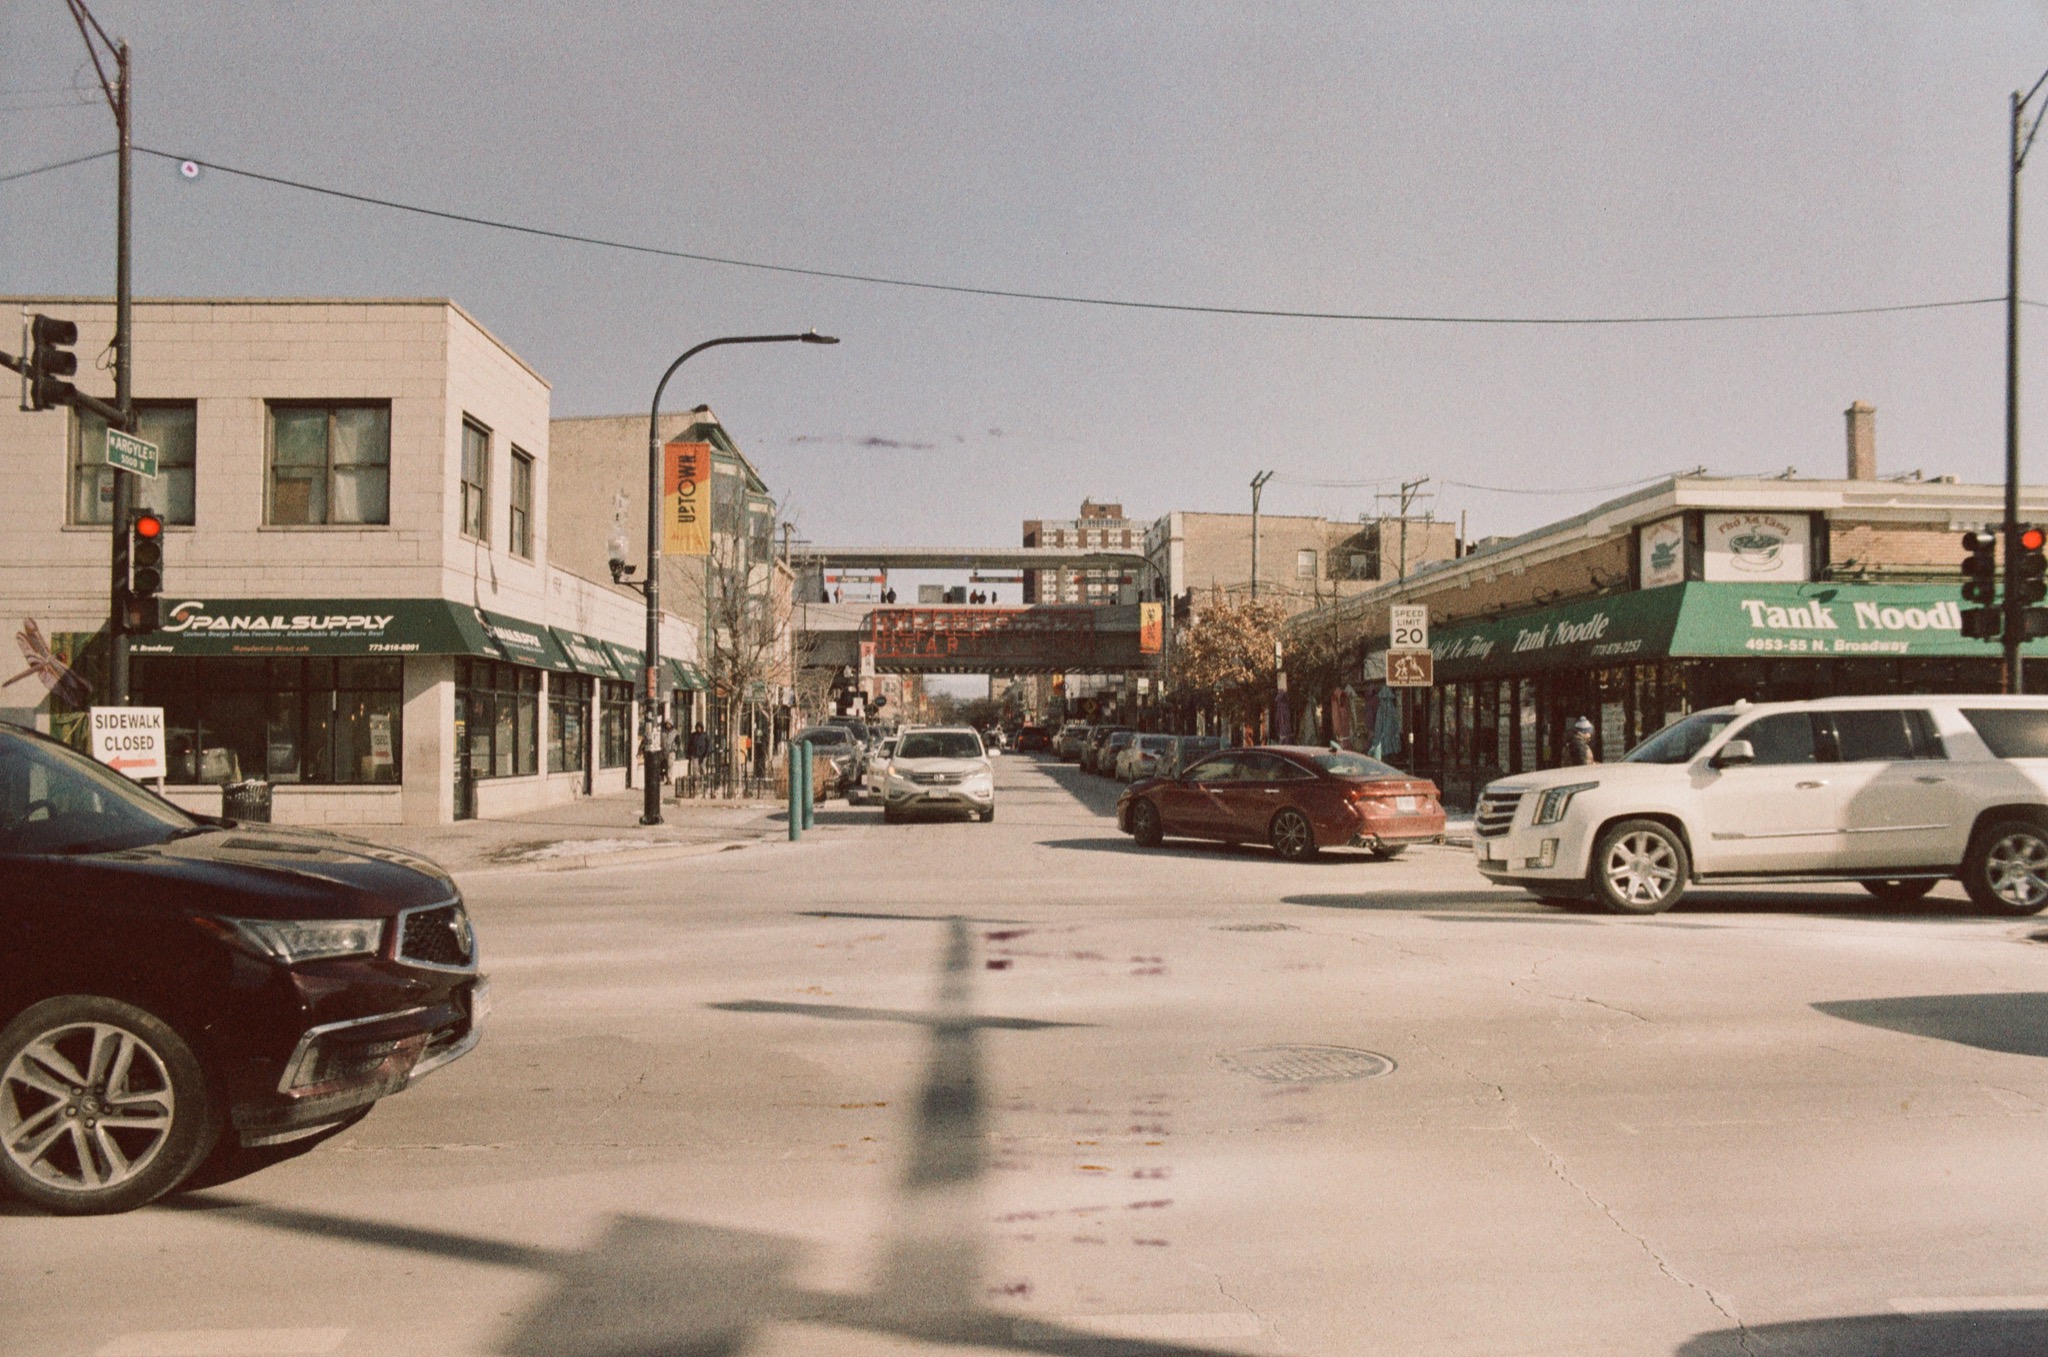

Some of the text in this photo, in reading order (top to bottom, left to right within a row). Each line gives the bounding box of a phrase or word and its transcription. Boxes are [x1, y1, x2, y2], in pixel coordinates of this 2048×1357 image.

[115, 437, 148, 460] ARGYLE
[678, 454, 696, 523] UPTOWN
[1394, 610, 1424, 618] SPEED
[1740, 600, 1963, 630] Tank Noodl
[1395, 628, 1424, 644] 20
[1512, 611, 1610, 653] Tank Noodle
[1745, 638, 1910, 654] 4953-55 N. Broadway
[95, 713, 161, 730] SIDEWALK
[104, 735, 155, 752] CLOSED
